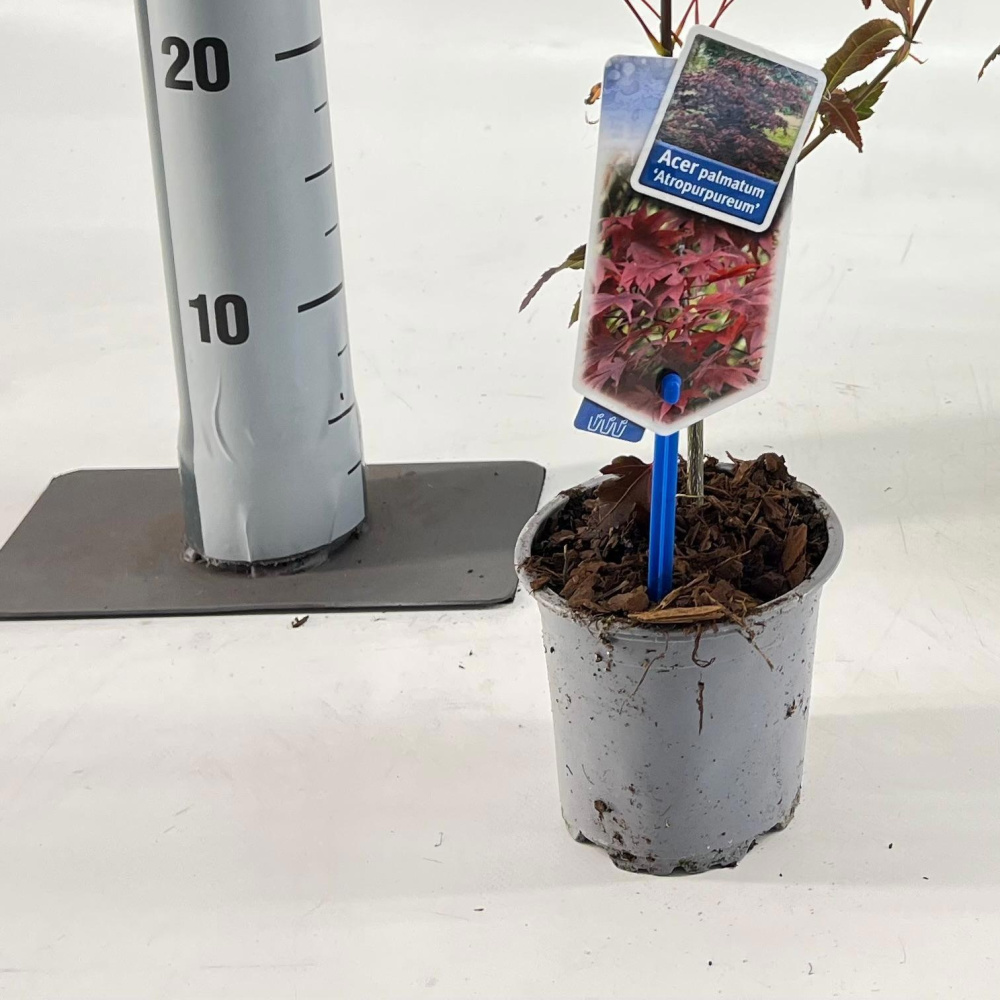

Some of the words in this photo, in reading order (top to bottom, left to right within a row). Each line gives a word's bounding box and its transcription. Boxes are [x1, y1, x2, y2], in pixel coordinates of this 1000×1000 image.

[161, 36, 230, 93] 20
[653, 167, 761, 215] ‘Atropurpureum’
[657, 149, 700, 175] Acer
[697, 167, 765, 199] palmatum
[189, 294, 250, 346] 10
